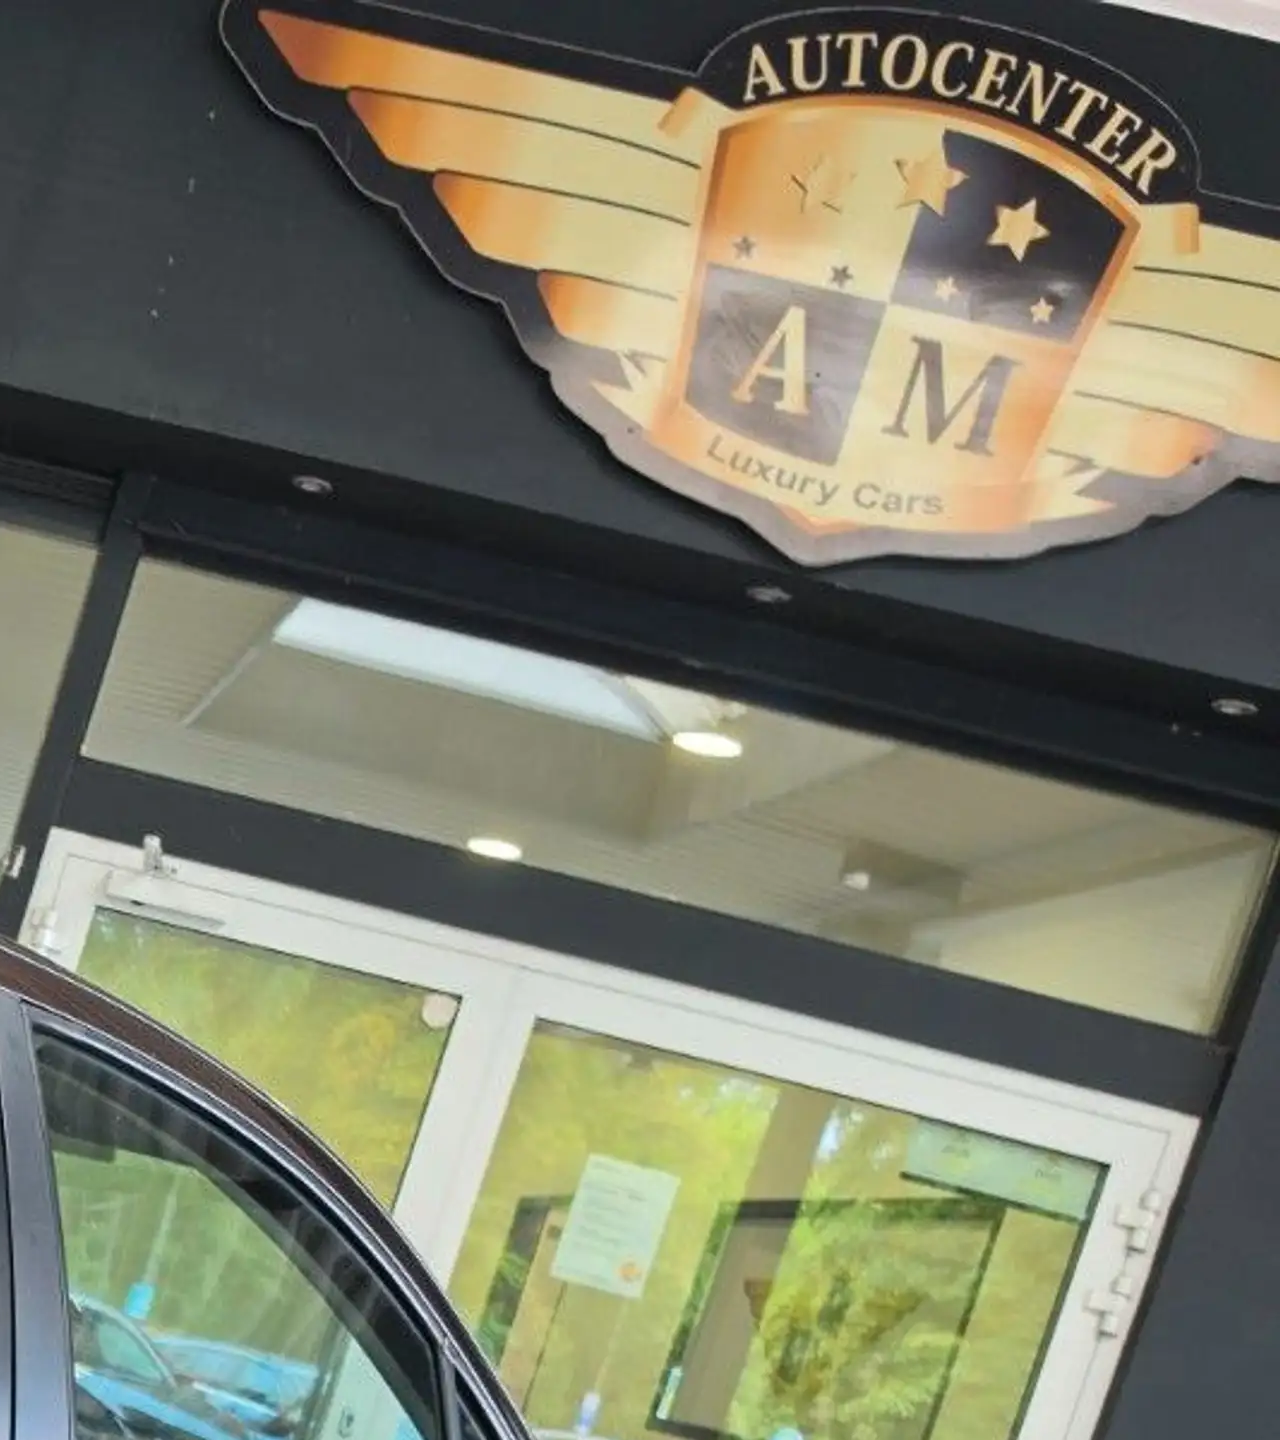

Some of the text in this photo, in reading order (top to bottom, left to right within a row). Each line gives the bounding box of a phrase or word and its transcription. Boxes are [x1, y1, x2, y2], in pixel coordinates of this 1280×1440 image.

[742, 32, 1178, 196] AUTOCENTER
[732, 306, 1021, 456] A M
[706, 434, 945, 516] Luxury Cars
